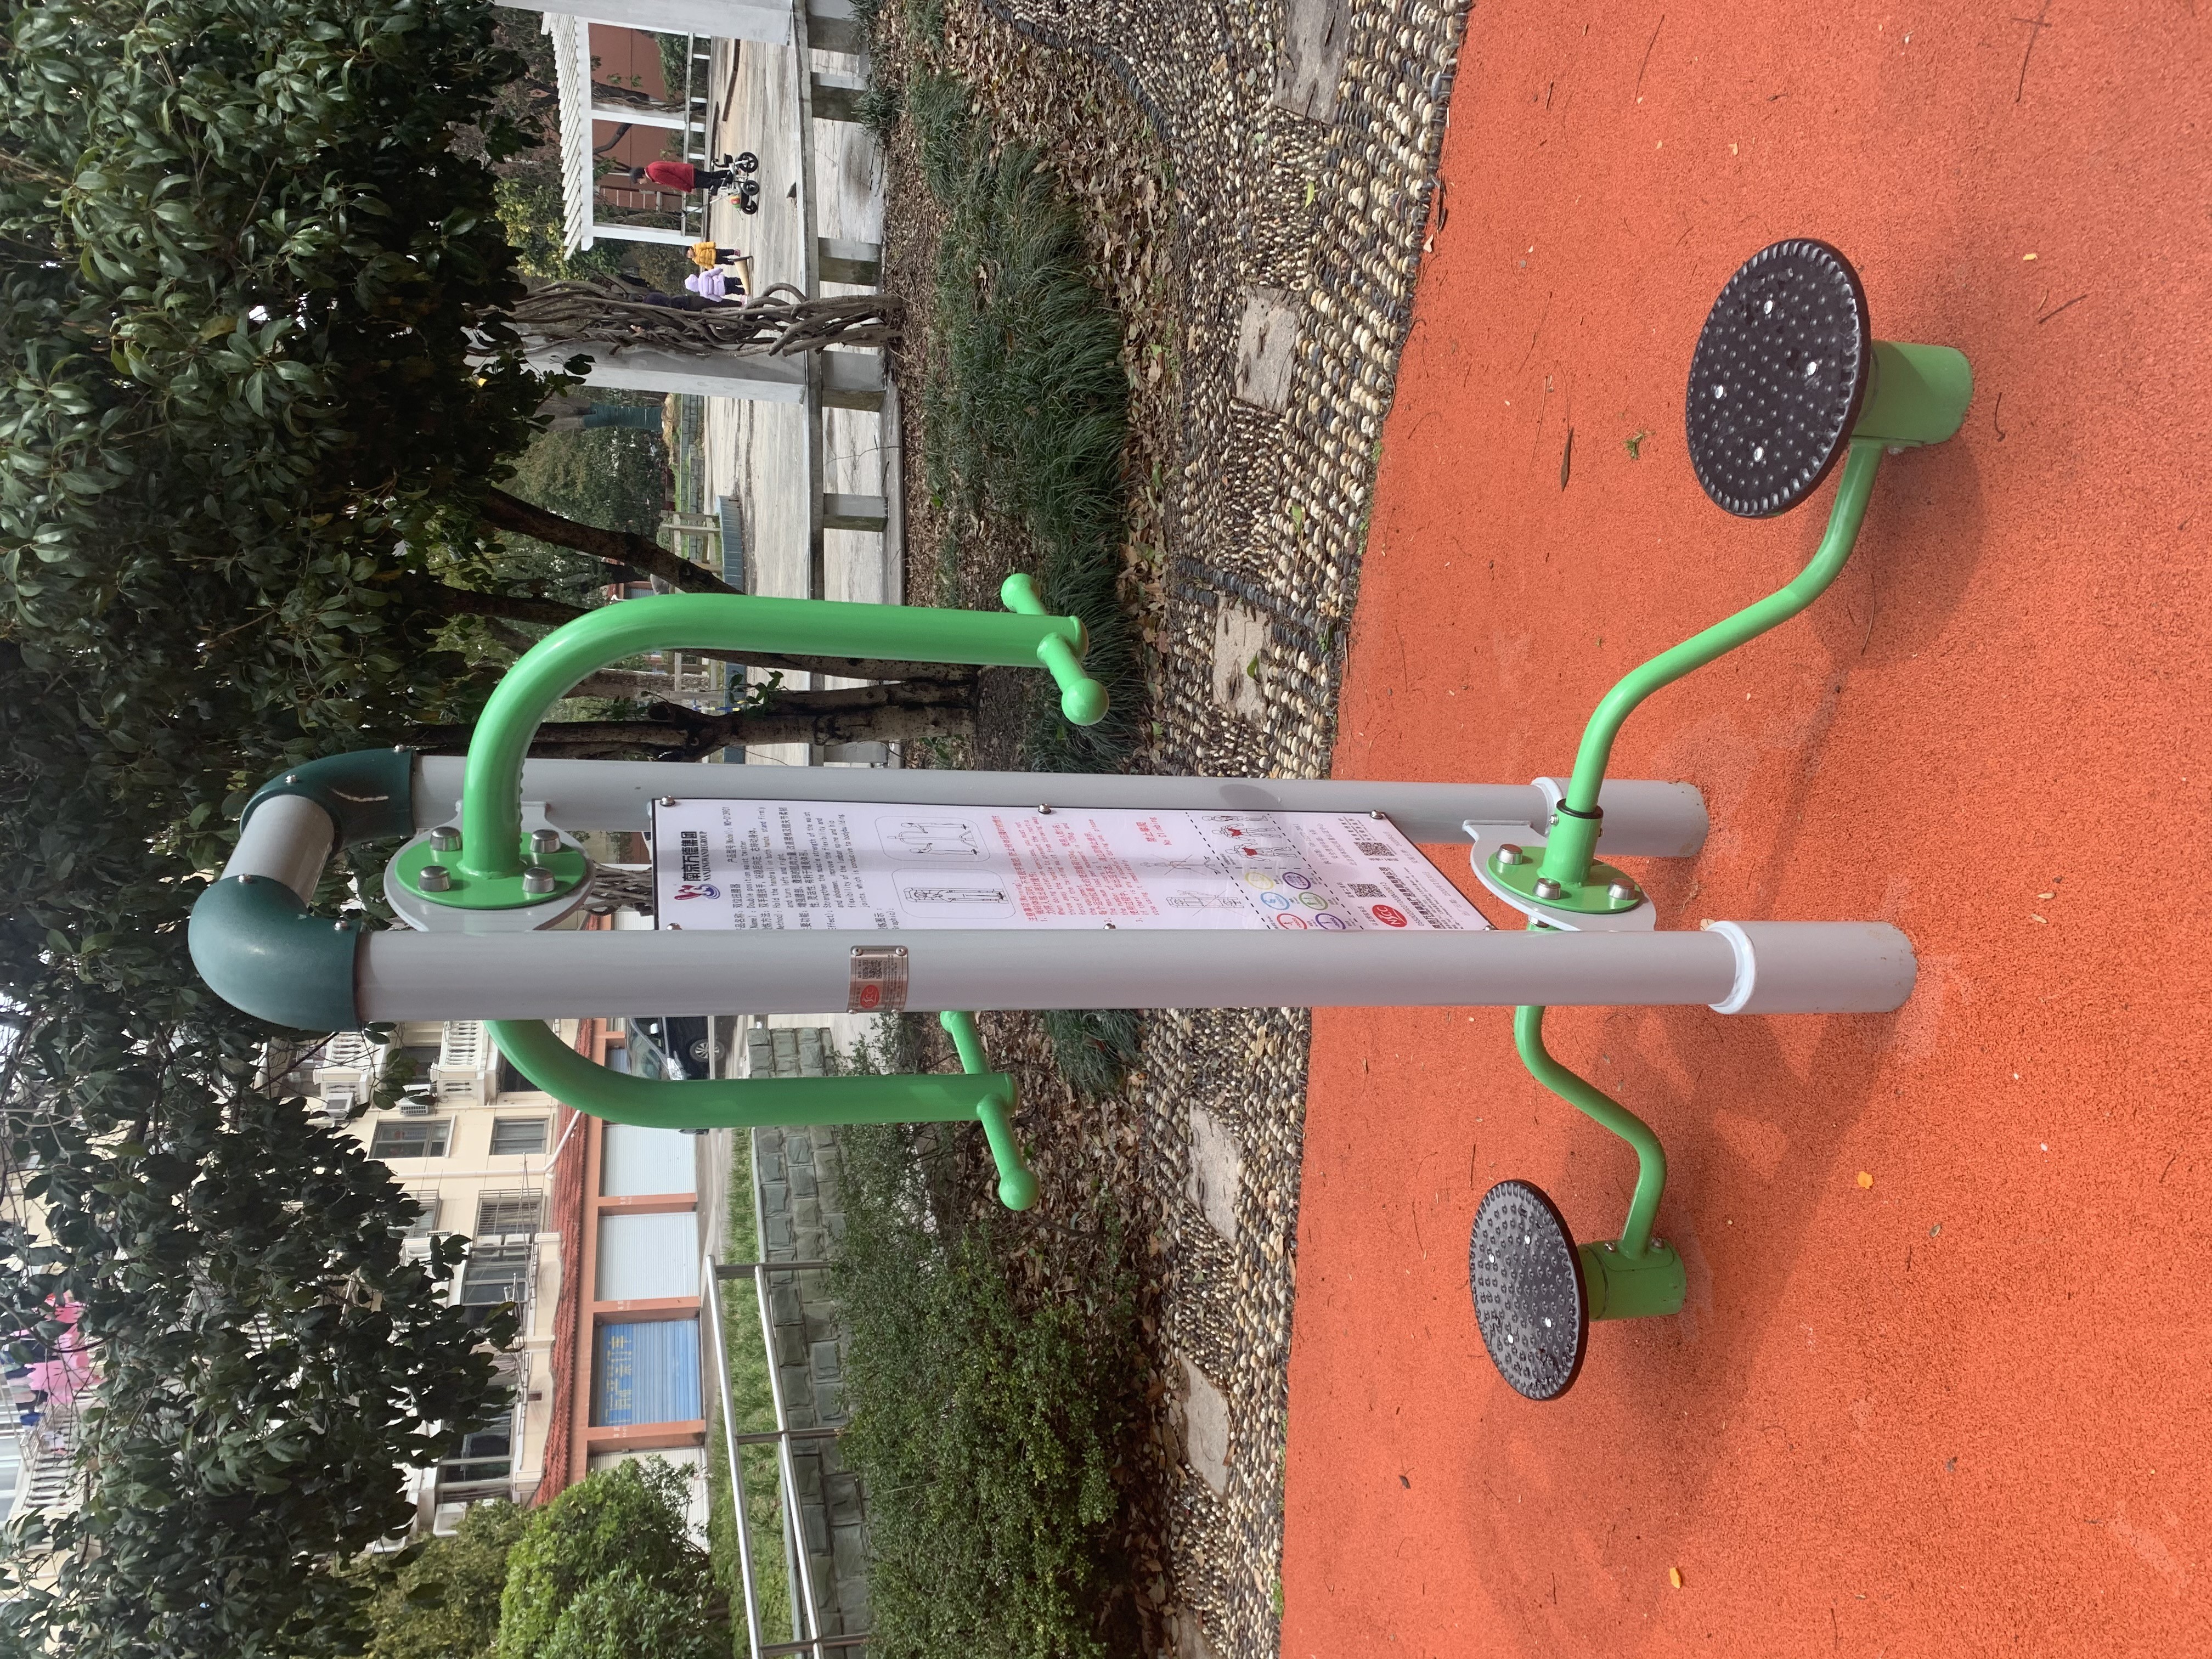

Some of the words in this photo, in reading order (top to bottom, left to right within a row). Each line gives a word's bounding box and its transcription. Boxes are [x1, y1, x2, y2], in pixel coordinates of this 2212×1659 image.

[757, 807, 766, 820] firmly
[759, 821, 768, 832] stand
[1024, 820, 1035, 834] inertia
[1088, 819, 1101, 832] please
[1136, 822, 1157, 842] 禁止攀爬
[1149, 817, 1167, 838] Climbing
[818, 826, 830, 850] flexibility
[1018, 830, 1027, 838] must
[1036, 826, 1048, 842] throwing
[740, 841, 748, 856] twister
[809, 839, 820, 856] strength
[832, 837, 842, 848] spine
[1046, 844, 1054, 853] from
[681, 831, 701, 881] 南京万德集团
[699, 831, 711, 881] NANJINGWANDEGROUP
[764, 849, 775, 859] both
[1035, 844, 1049, 859] prevent
[1102, 843, 1113, 856] during
[834, 850, 844, 864] lumbar
[846, 848, 857, 868] conducive
[1049, 855, 1060, 865] waist
[1077, 851, 1093, 868] movement
[741, 858, 751, 870] waist
[813, 859, 823, 872] muscle
[827, 861, 837, 876] improve
[1109, 858, 1127, 879] discomfort
[765, 868, 777, 886] handrail
[1038, 871, 1053, 889] rotation
[1045, 867, 1058, 881] handle
[1055, 867, 1070, 885] twisting
[1099, 872, 1110, 883] users
[743, 872, 754, 891] position
[780, 877, 789, 885] left
[853, 877, 863, 889] which
[1091, 878, 1102, 887] load
[746, 893, 755, 908] Double
[820, 884, 831, 908] Strengthen
[844, 882, 856, 907] flexibility
[1049, 891, 1060, 904] doing
[1060, 891, 1069, 901] away
[1099, 889, 1113, 906] maximum
[1111, 893, 1124, 906] number
[1141, 892, 1153, 904] using
[771, 898, 781, 909] Hold
[1066, 903, 1076, 915] throw
[1076, 904, 1087, 915] force
[1134, 897, 1144, 909] there
[1056, 905, 1066, 915] When
[1150, 906, 1159, 915] stop
[747, 916, 759, 930] Name)
